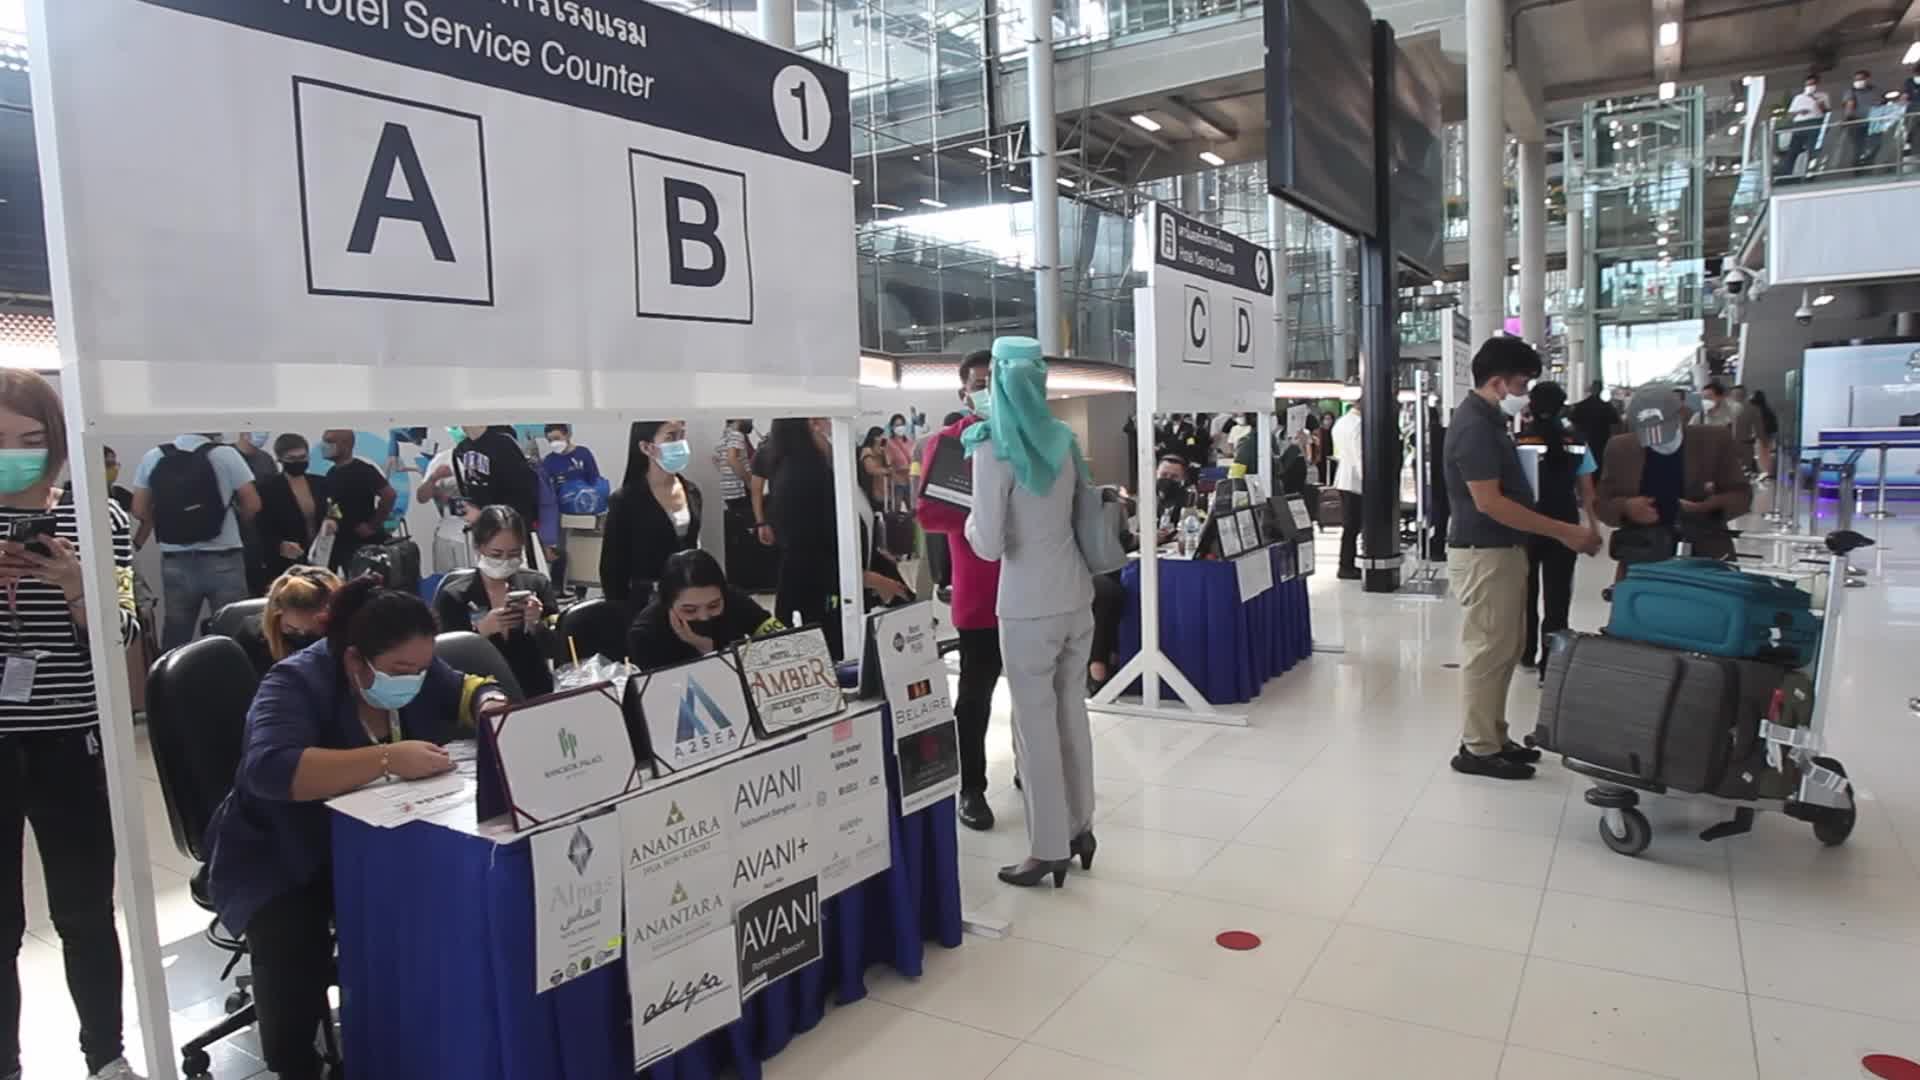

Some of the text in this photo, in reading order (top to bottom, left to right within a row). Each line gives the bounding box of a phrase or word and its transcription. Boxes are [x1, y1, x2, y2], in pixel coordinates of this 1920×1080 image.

[282, 0, 654, 100] otel Service Counter
[790, 80, 811, 141] 1
[347, 121, 456, 263] A
[663, 176, 727, 288] B
[1190, 296, 1207, 348] C
[1237, 308, 1251, 353] D
[752, 656, 838, 697] AMBER
[673, 727, 737, 759] A2SEA
[734, 764, 801, 813] AVANI
[630, 816, 720, 864] ANANTARA
[733, 837, 808, 888] AVANI+
[633, 895, 723, 944] ANANTARA
[741, 891, 817, 961] AVANI
